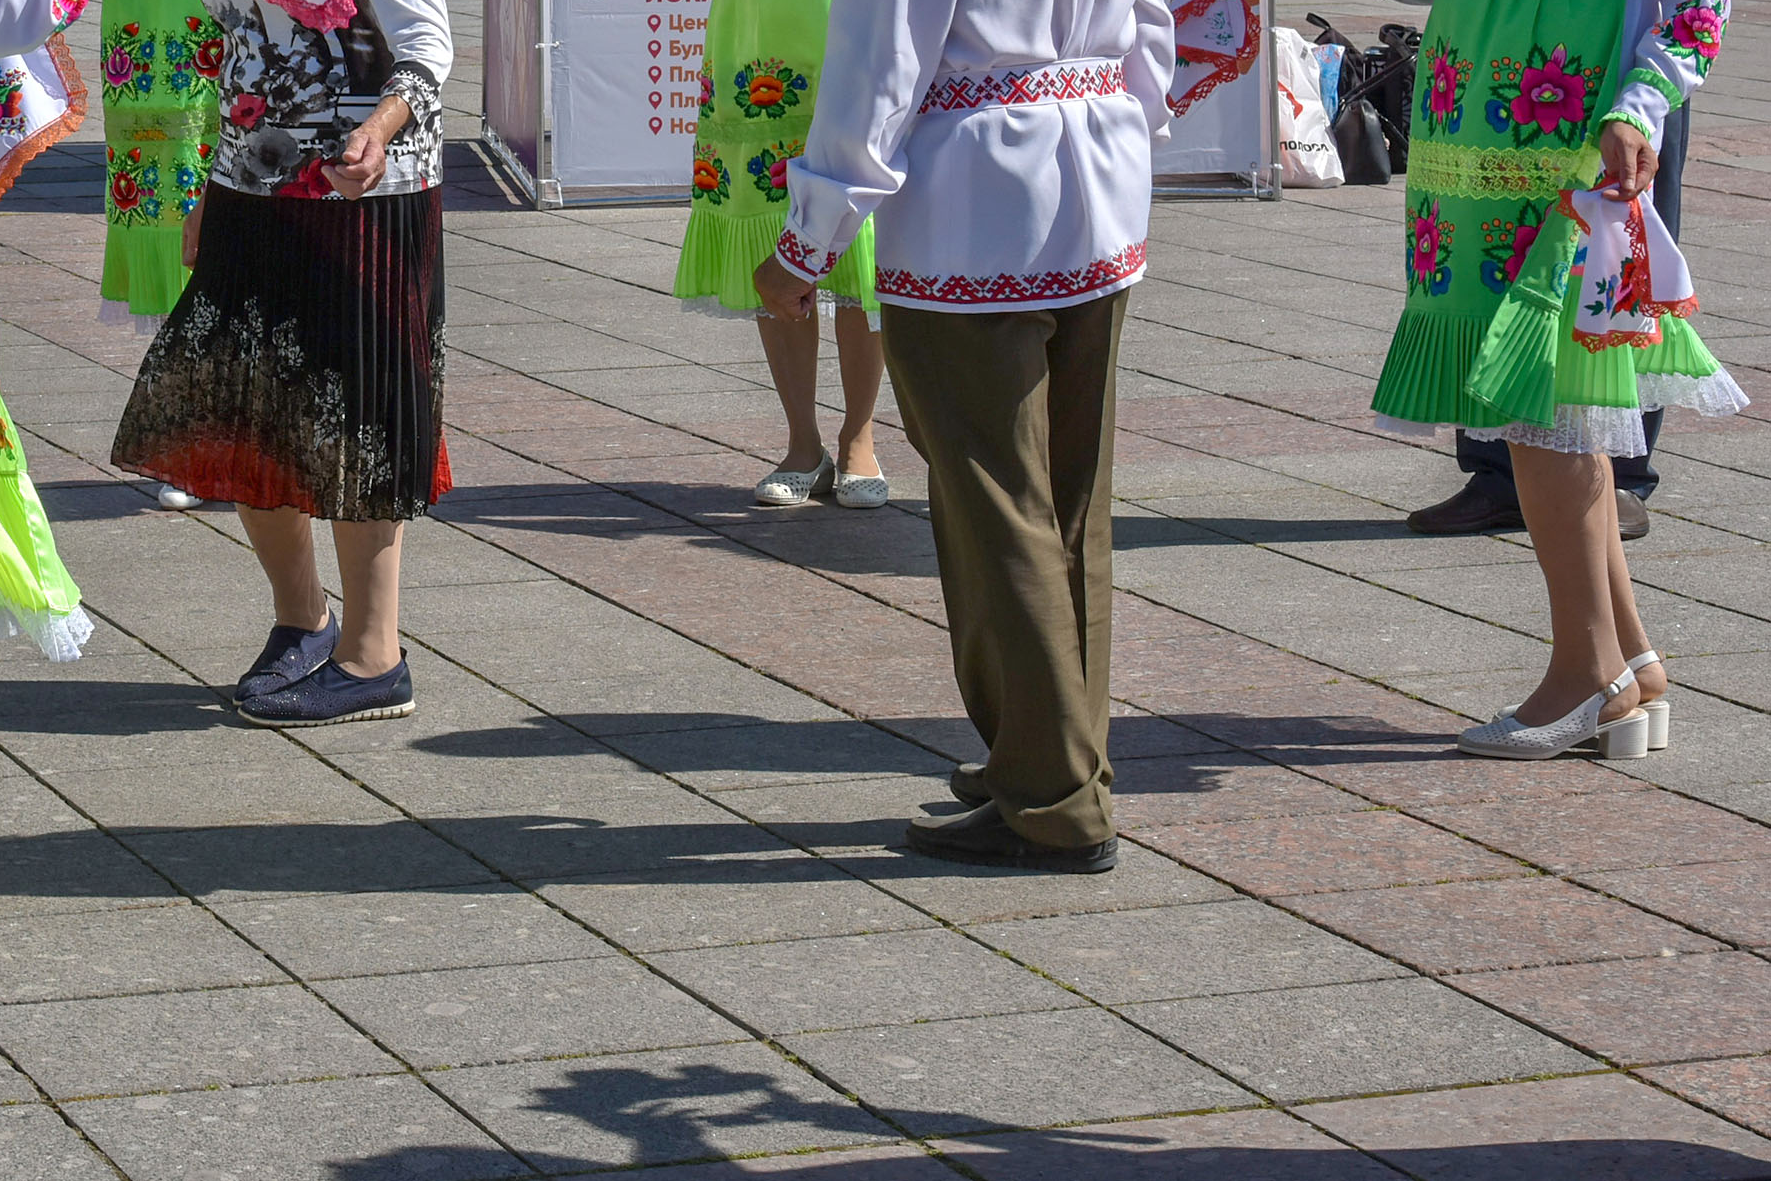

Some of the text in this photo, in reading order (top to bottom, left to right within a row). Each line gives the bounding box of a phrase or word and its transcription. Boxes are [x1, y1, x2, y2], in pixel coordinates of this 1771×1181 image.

[669, 14, 708, 33] Цен
[669, 40, 703, 60] Бул
[670, 118, 698, 134] На
